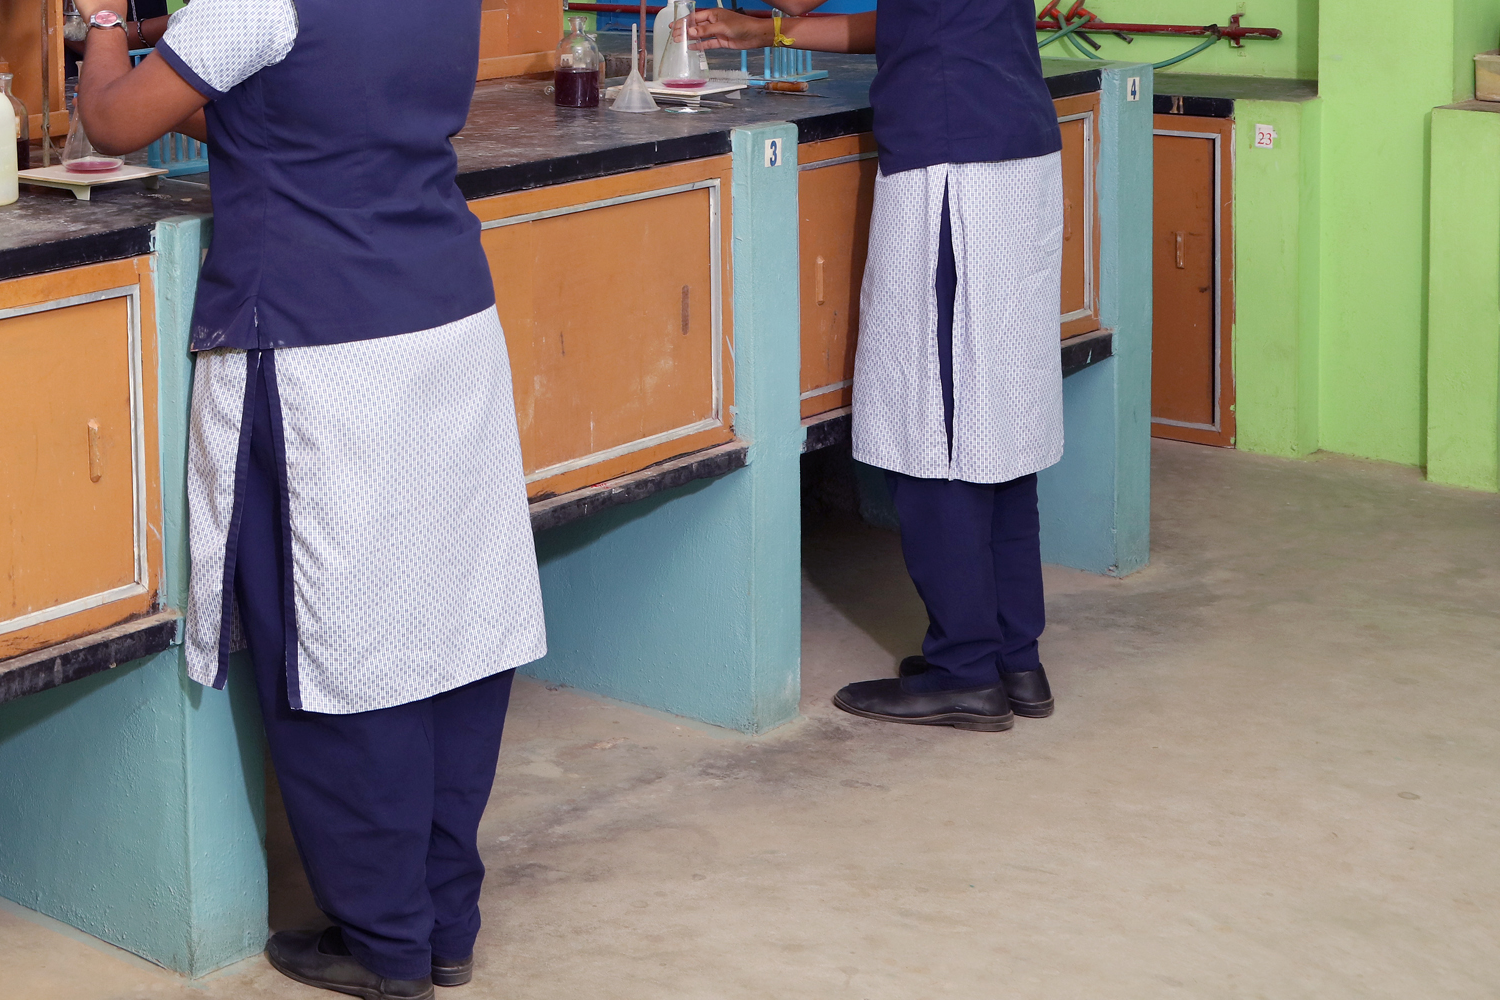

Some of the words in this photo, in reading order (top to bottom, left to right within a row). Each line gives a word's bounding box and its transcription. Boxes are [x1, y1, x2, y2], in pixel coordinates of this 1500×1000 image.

[1130, 78, 1137, 100] 4
[1257, 131, 1273, 146] 23
[769, 140, 778, 167] 3
